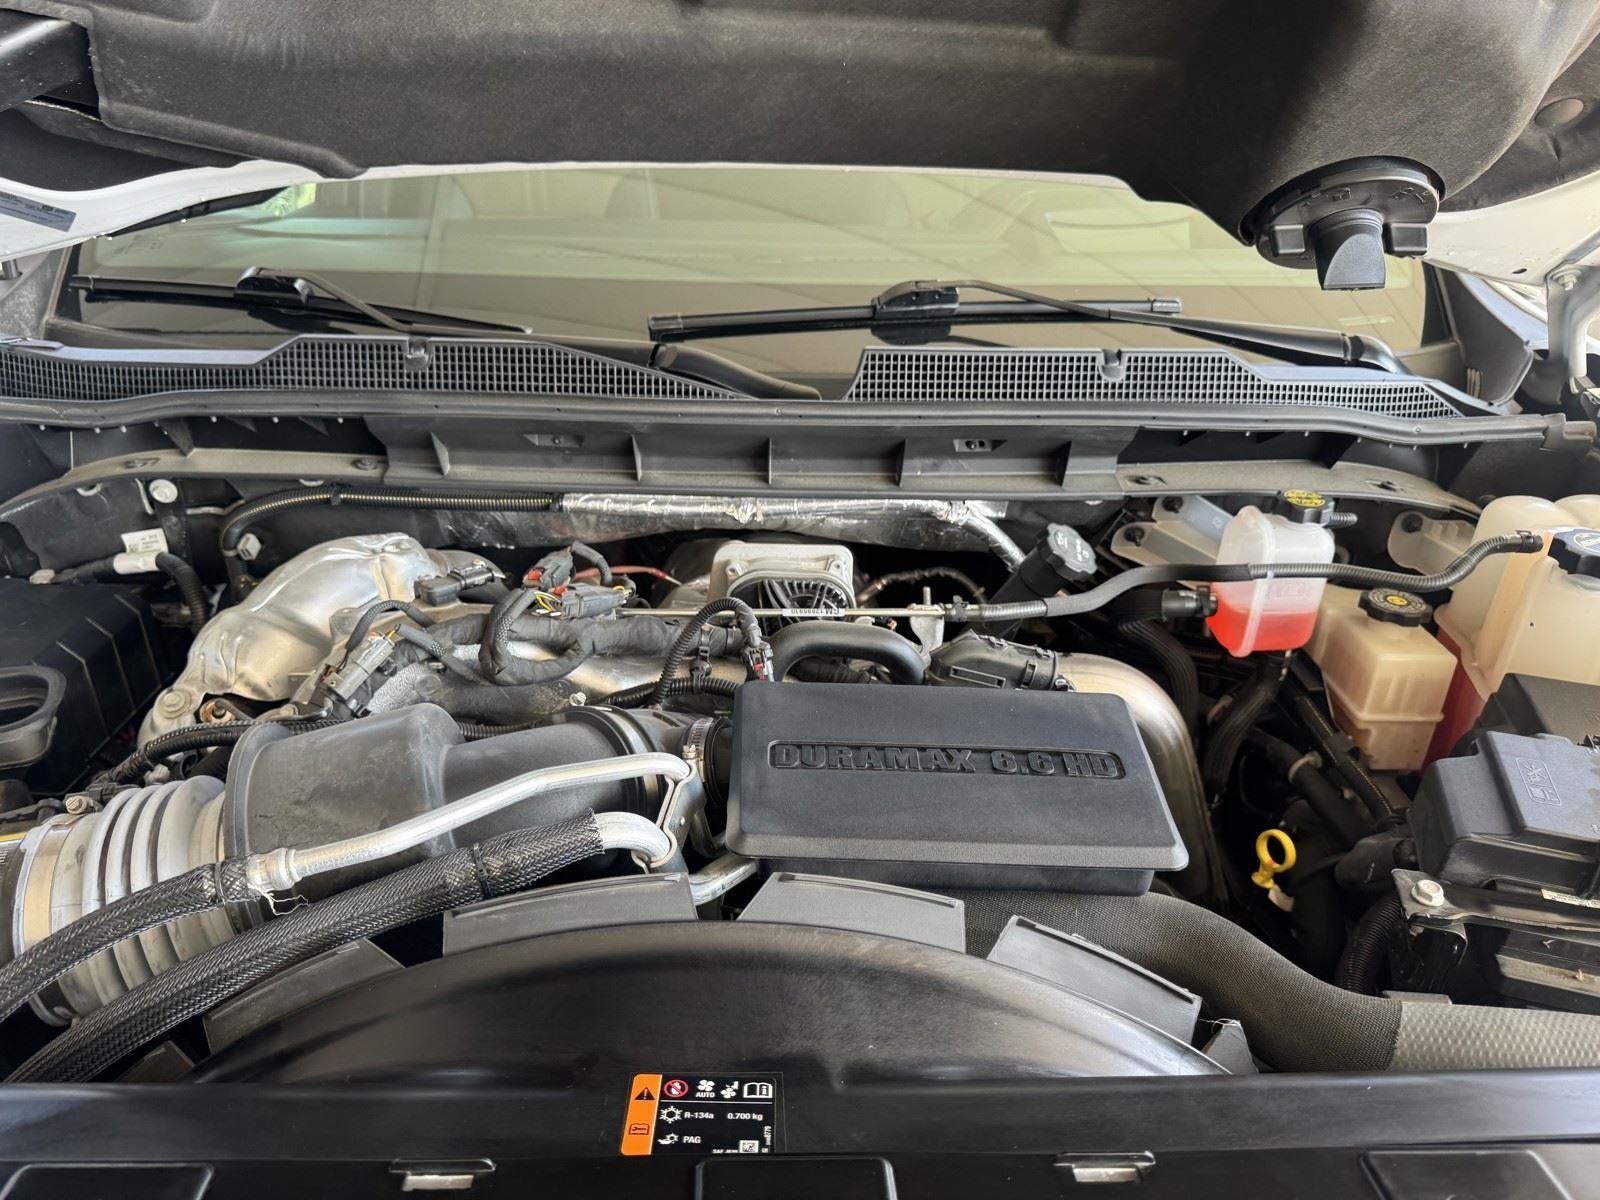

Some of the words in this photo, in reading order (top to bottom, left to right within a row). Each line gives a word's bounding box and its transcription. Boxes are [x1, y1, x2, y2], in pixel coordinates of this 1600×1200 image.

[775, 744, 976, 773] DURAMAX
[989, 750, 1056, 776] 6.6
[1062, 751, 1121, 779] HD
[684, 1111, 715, 1119] R-134a
[727, 1112, 751, 1120] 0.700
[752, 1112, 763, 1121] kg
[683, 1135, 701, 1144] PAG
